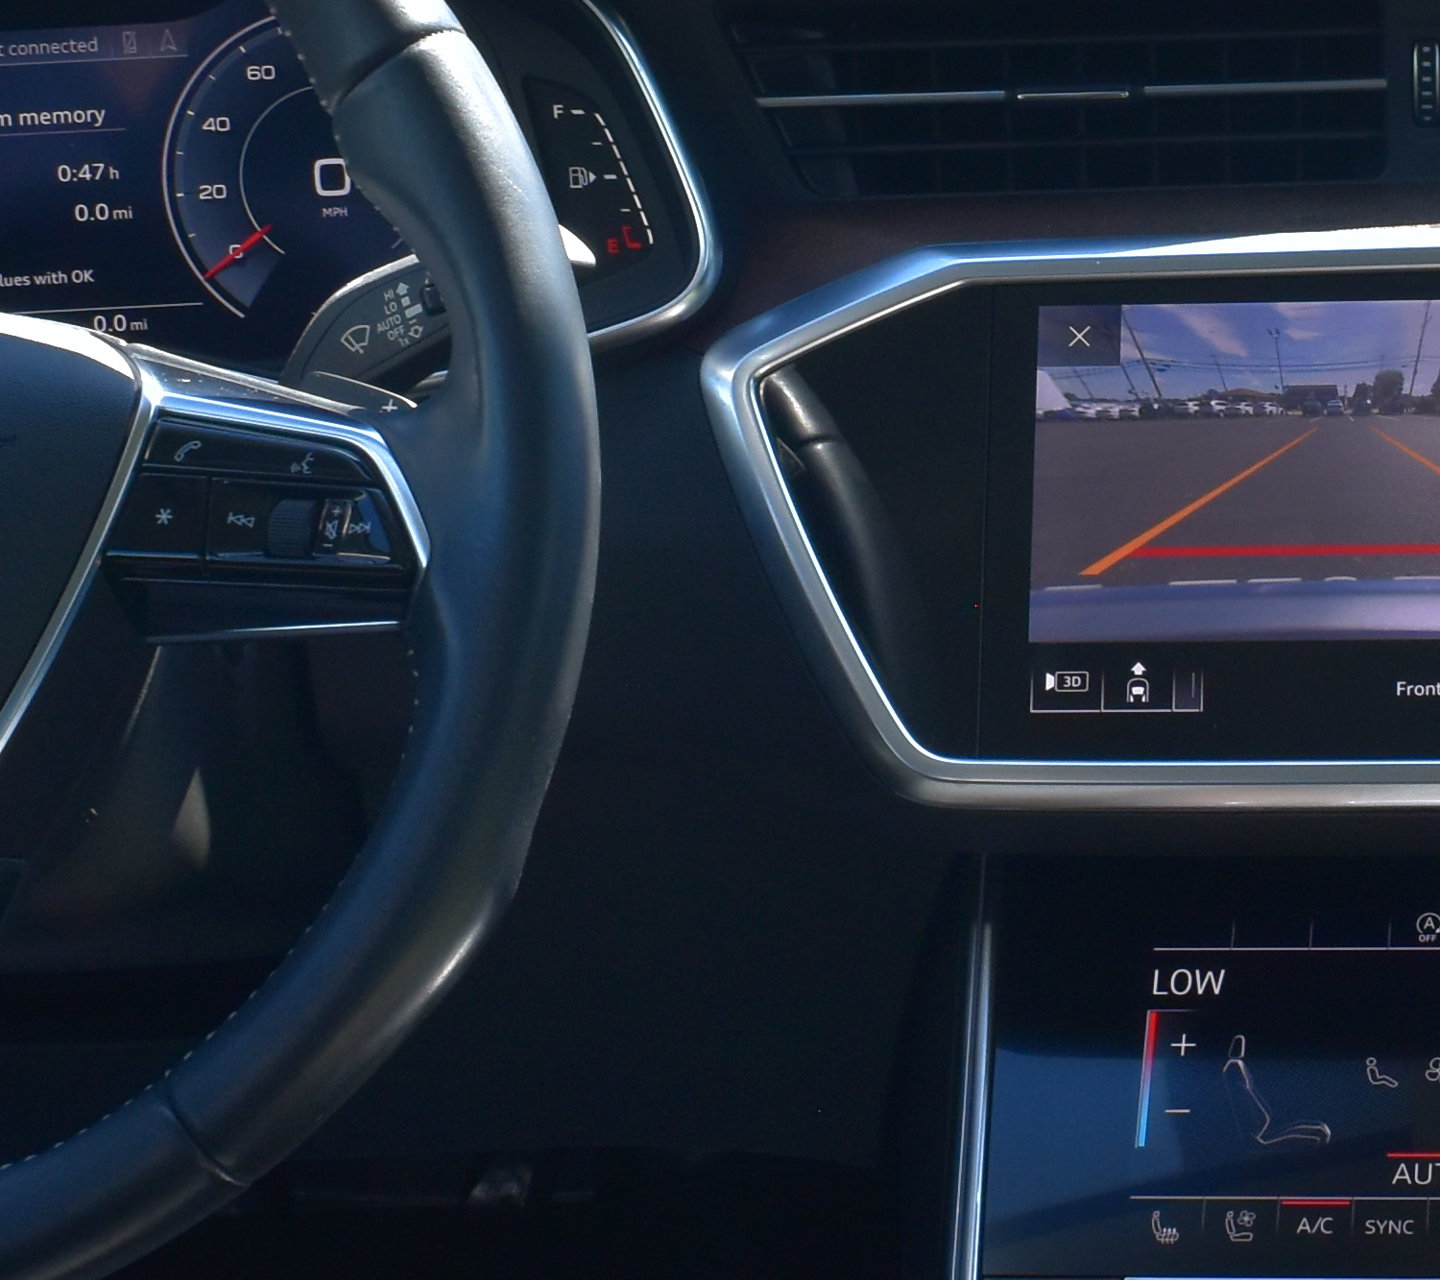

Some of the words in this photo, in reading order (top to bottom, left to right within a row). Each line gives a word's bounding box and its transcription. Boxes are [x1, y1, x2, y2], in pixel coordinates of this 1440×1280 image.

[7, 37, 99, 56] connected
[246, 65, 276, 81] 60
[19, 107, 106, 128] memory
[552, 104, 565, 120] F
[202, 116, 231, 133] 40
[57, 164, 105, 183] 0:47
[108, 166, 120, 181] h
[198, 184, 228, 200] 20
[75, 203, 108, 223] 0.0
[113, 205, 134, 221] mi
[321, 206, 349, 218] MPH
[34, 270, 68, 286] with
[71, 268, 95, 284] OK
[384, 301, 399, 315] LO
[93, 313, 128, 332] 0.0
[129, 317, 148, 332] mi
[377, 314, 403, 334] AUTO
[387, 324, 406, 341] OFF
[1062, 673, 1083, 690] 3D
[1150, 968, 1225, 996] LOW
[1296, 1215, 1334, 1237] A/C
[1364, 1216, 1414, 1237] SYNC
